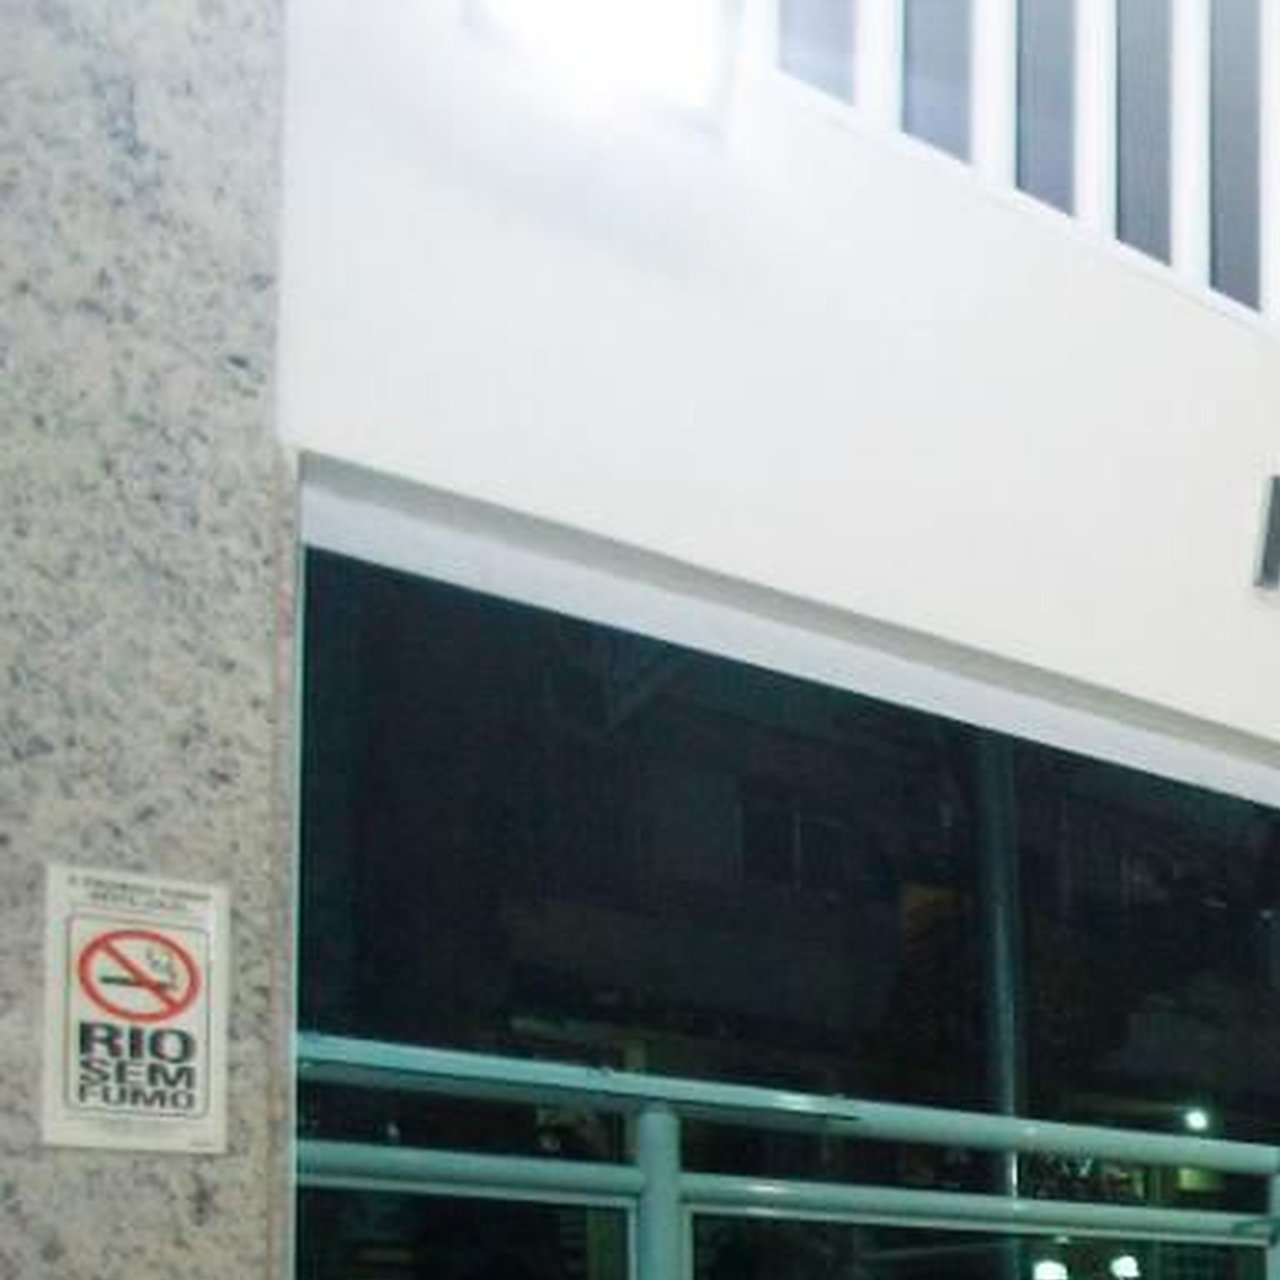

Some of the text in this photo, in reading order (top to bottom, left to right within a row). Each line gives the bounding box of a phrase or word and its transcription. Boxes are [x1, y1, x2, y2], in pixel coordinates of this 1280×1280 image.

[79, 1021, 197, 1063] RIO
[79, 1058, 195, 1091] SEM
[79, 1084, 196, 1111] FUMO
